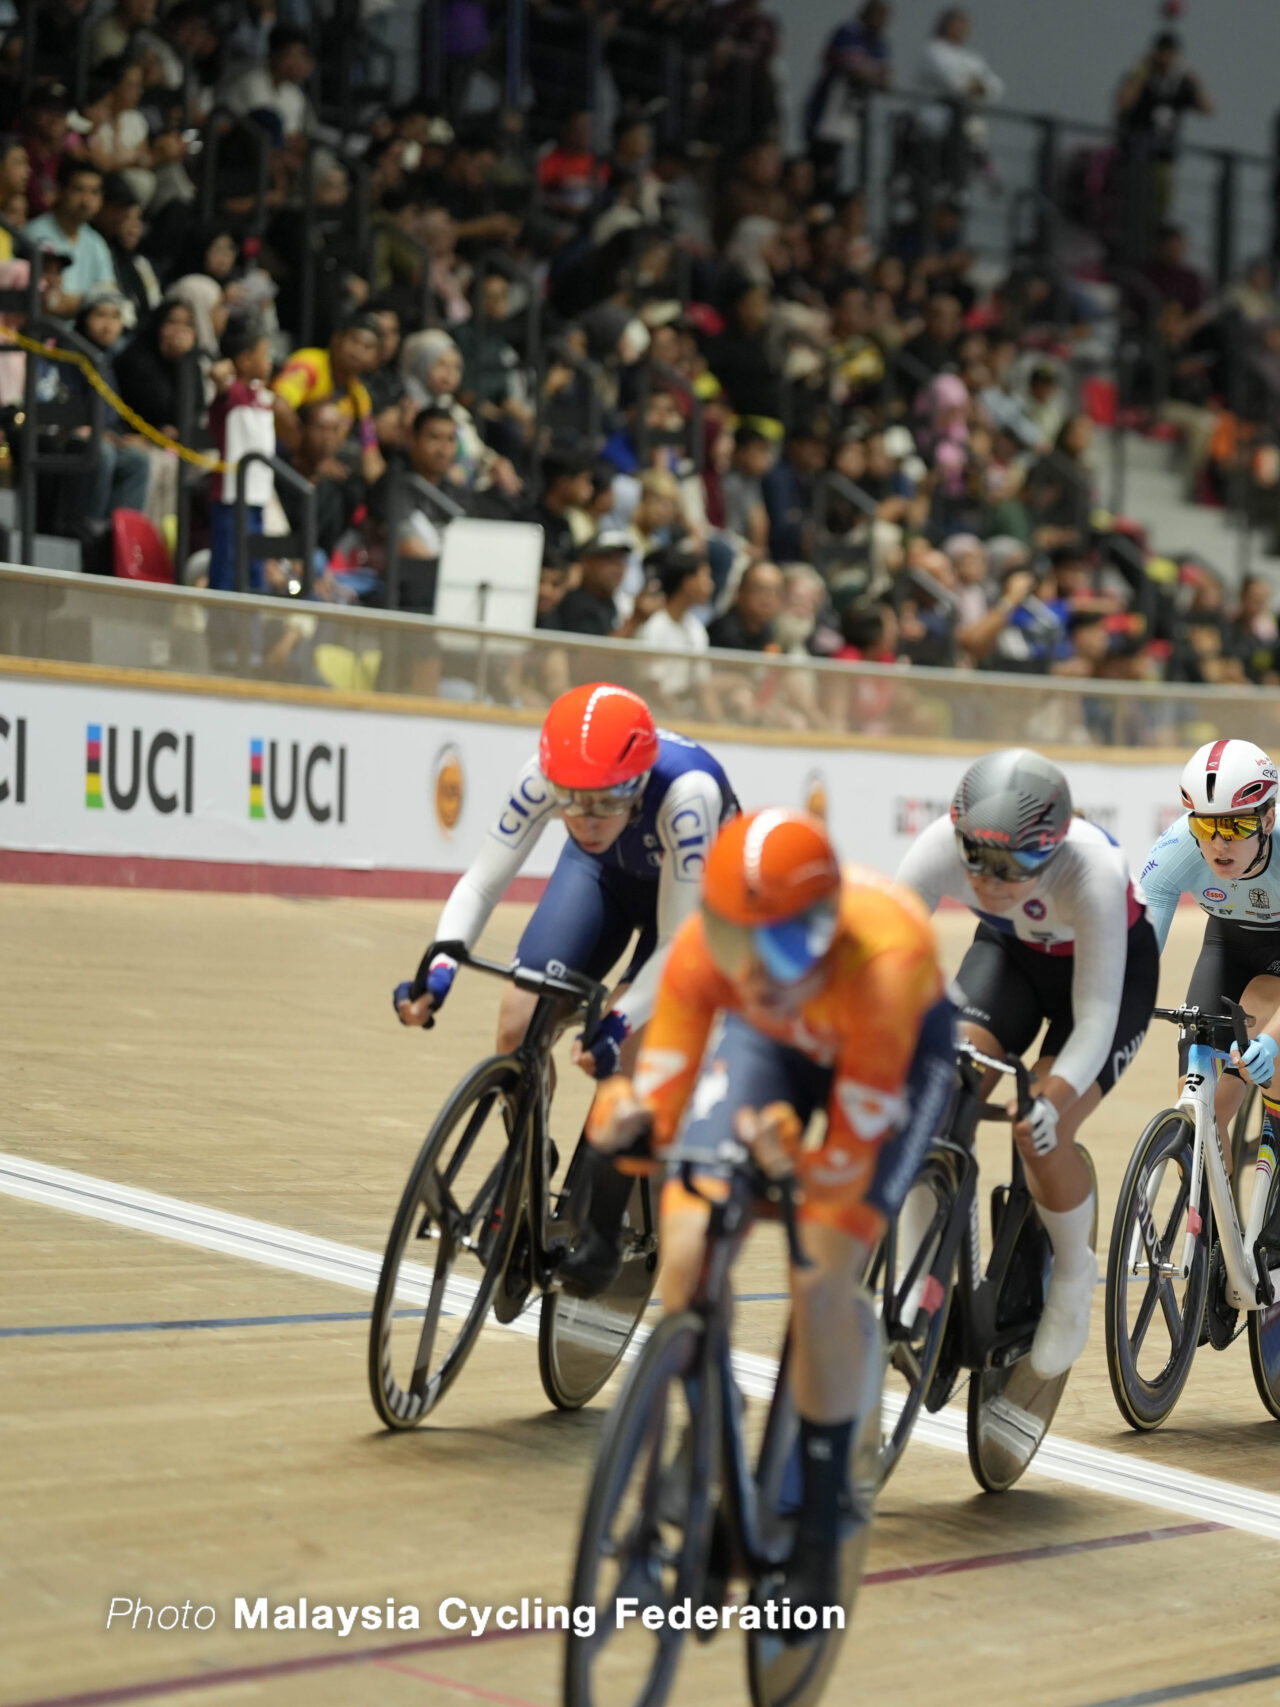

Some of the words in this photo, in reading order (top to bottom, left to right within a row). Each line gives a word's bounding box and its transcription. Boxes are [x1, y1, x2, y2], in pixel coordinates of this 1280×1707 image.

[107, 726, 194, 815] UCI
[269, 739, 346, 824] UCI
[498, 776, 547, 835] CIC
[671, 809, 706, 873] CIC
[1206, 891, 1224, 899] Esso
